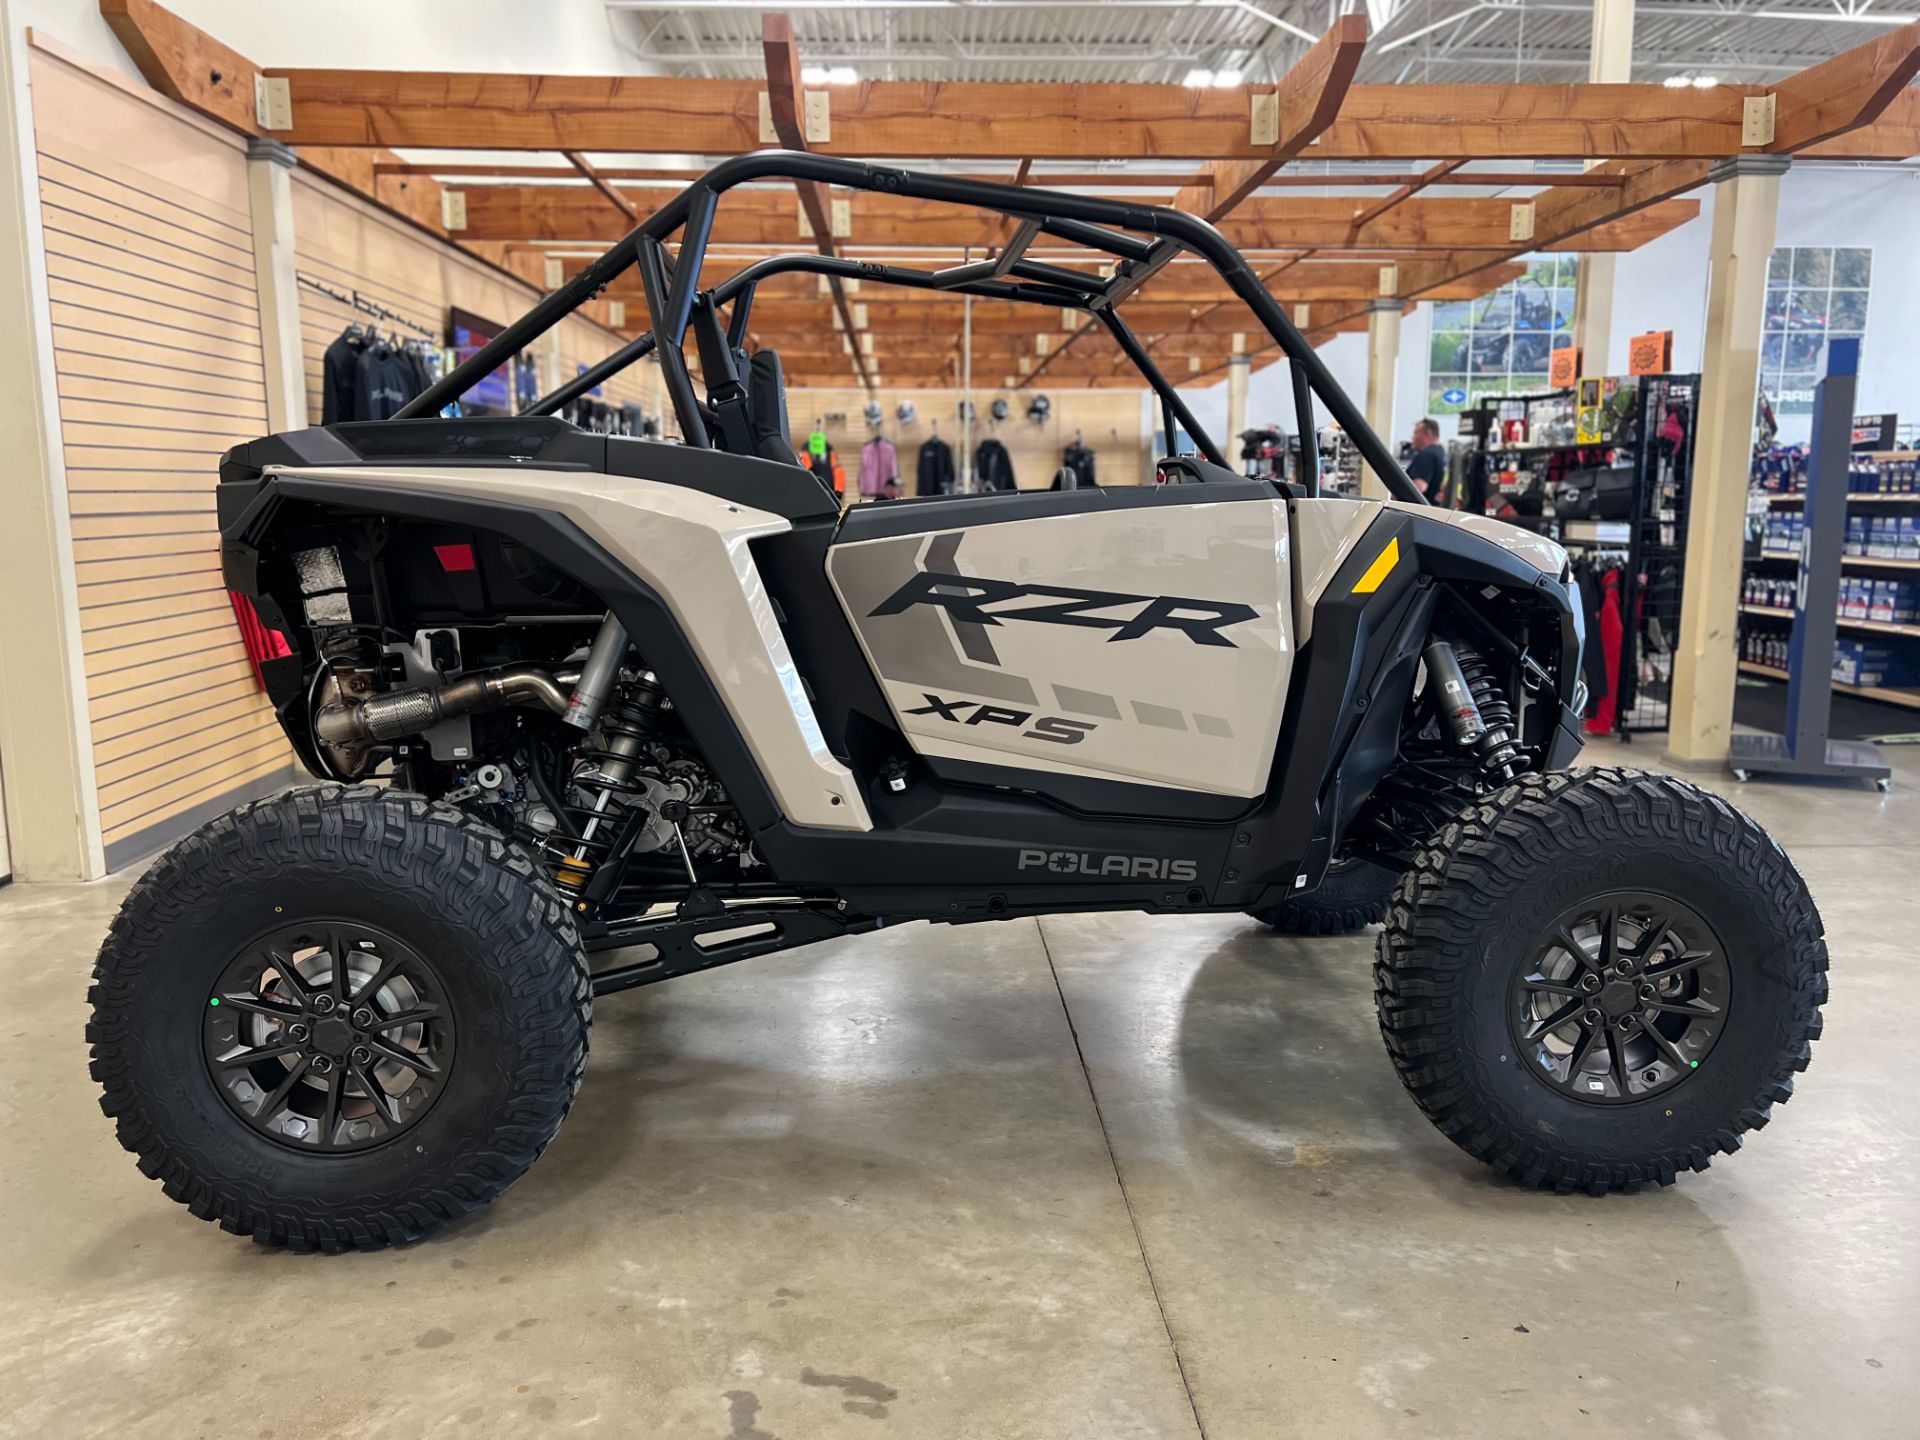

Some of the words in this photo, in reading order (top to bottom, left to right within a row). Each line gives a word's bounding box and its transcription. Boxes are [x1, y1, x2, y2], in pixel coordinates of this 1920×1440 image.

[866, 571, 1261, 648] RZR
[900, 693, 1098, 745] XPS
[1018, 849, 1197, 881] POLARIS
